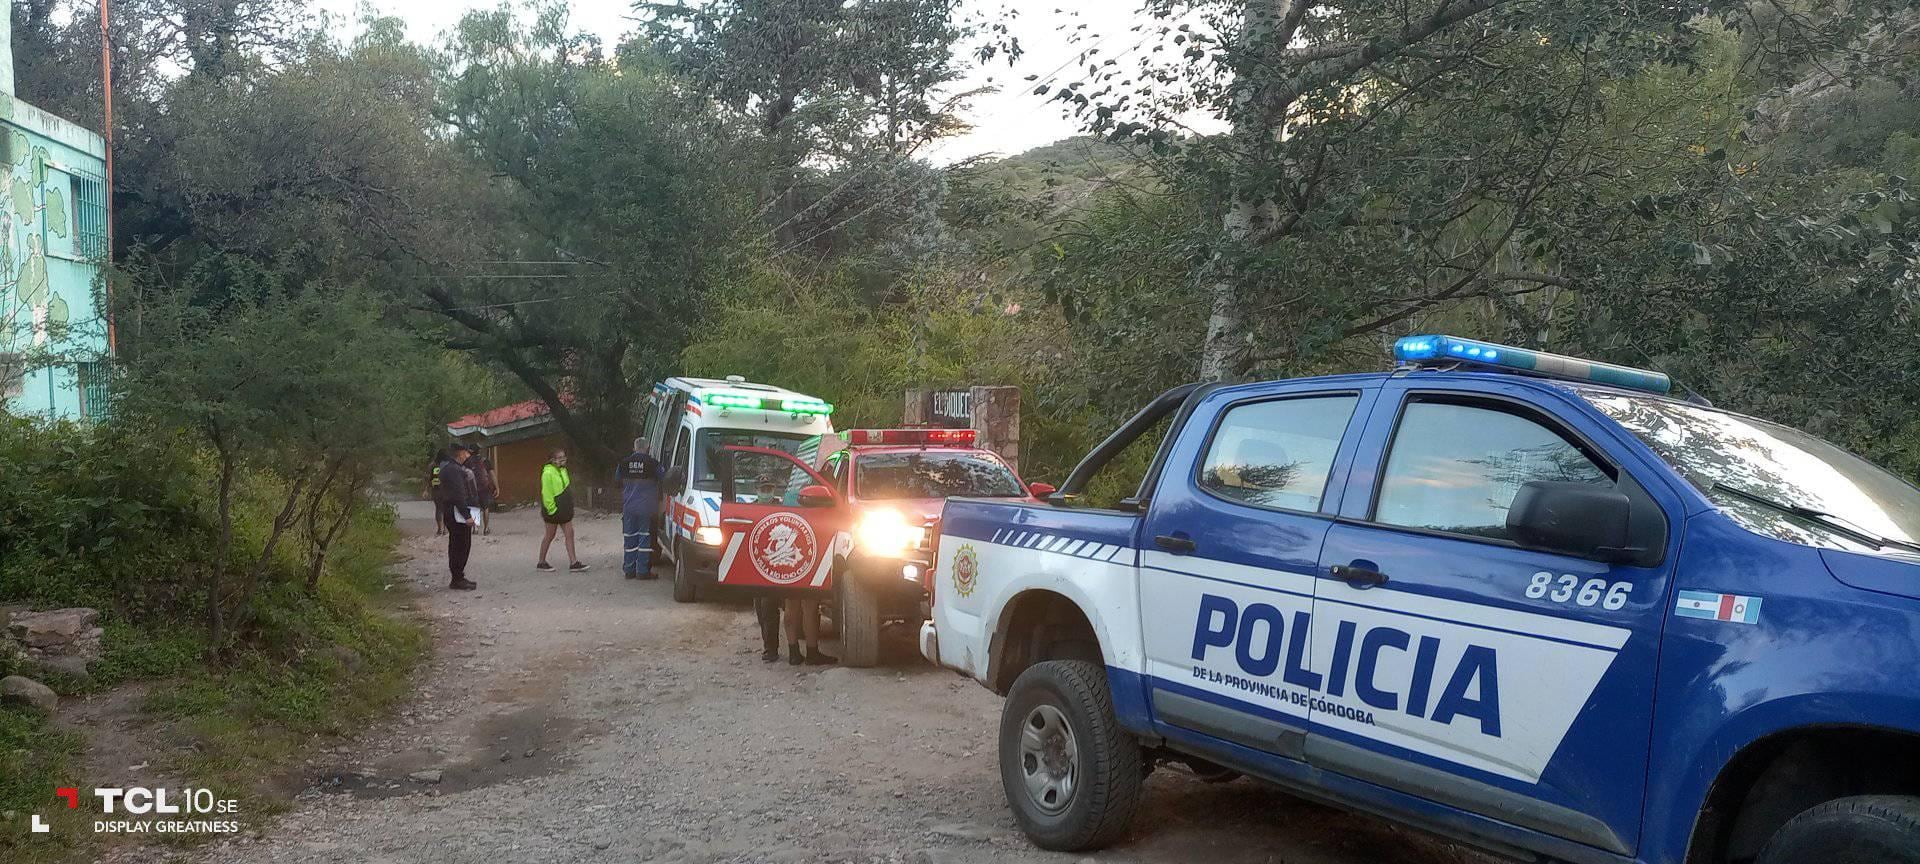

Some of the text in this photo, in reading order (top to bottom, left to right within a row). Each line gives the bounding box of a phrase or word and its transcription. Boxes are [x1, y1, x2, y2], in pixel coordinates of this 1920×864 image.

[934, 391, 971, 419] EL DIQUEC
[628, 461, 644, 469] SEM
[779, 516, 812, 545] VOLUNTARIOS
[1525, 572, 1633, 611] 8366
[1191, 593, 1502, 739] POLICIA
[1193, 666, 1376, 726] DE LA PROVINCIA DE CÓRDOBA
